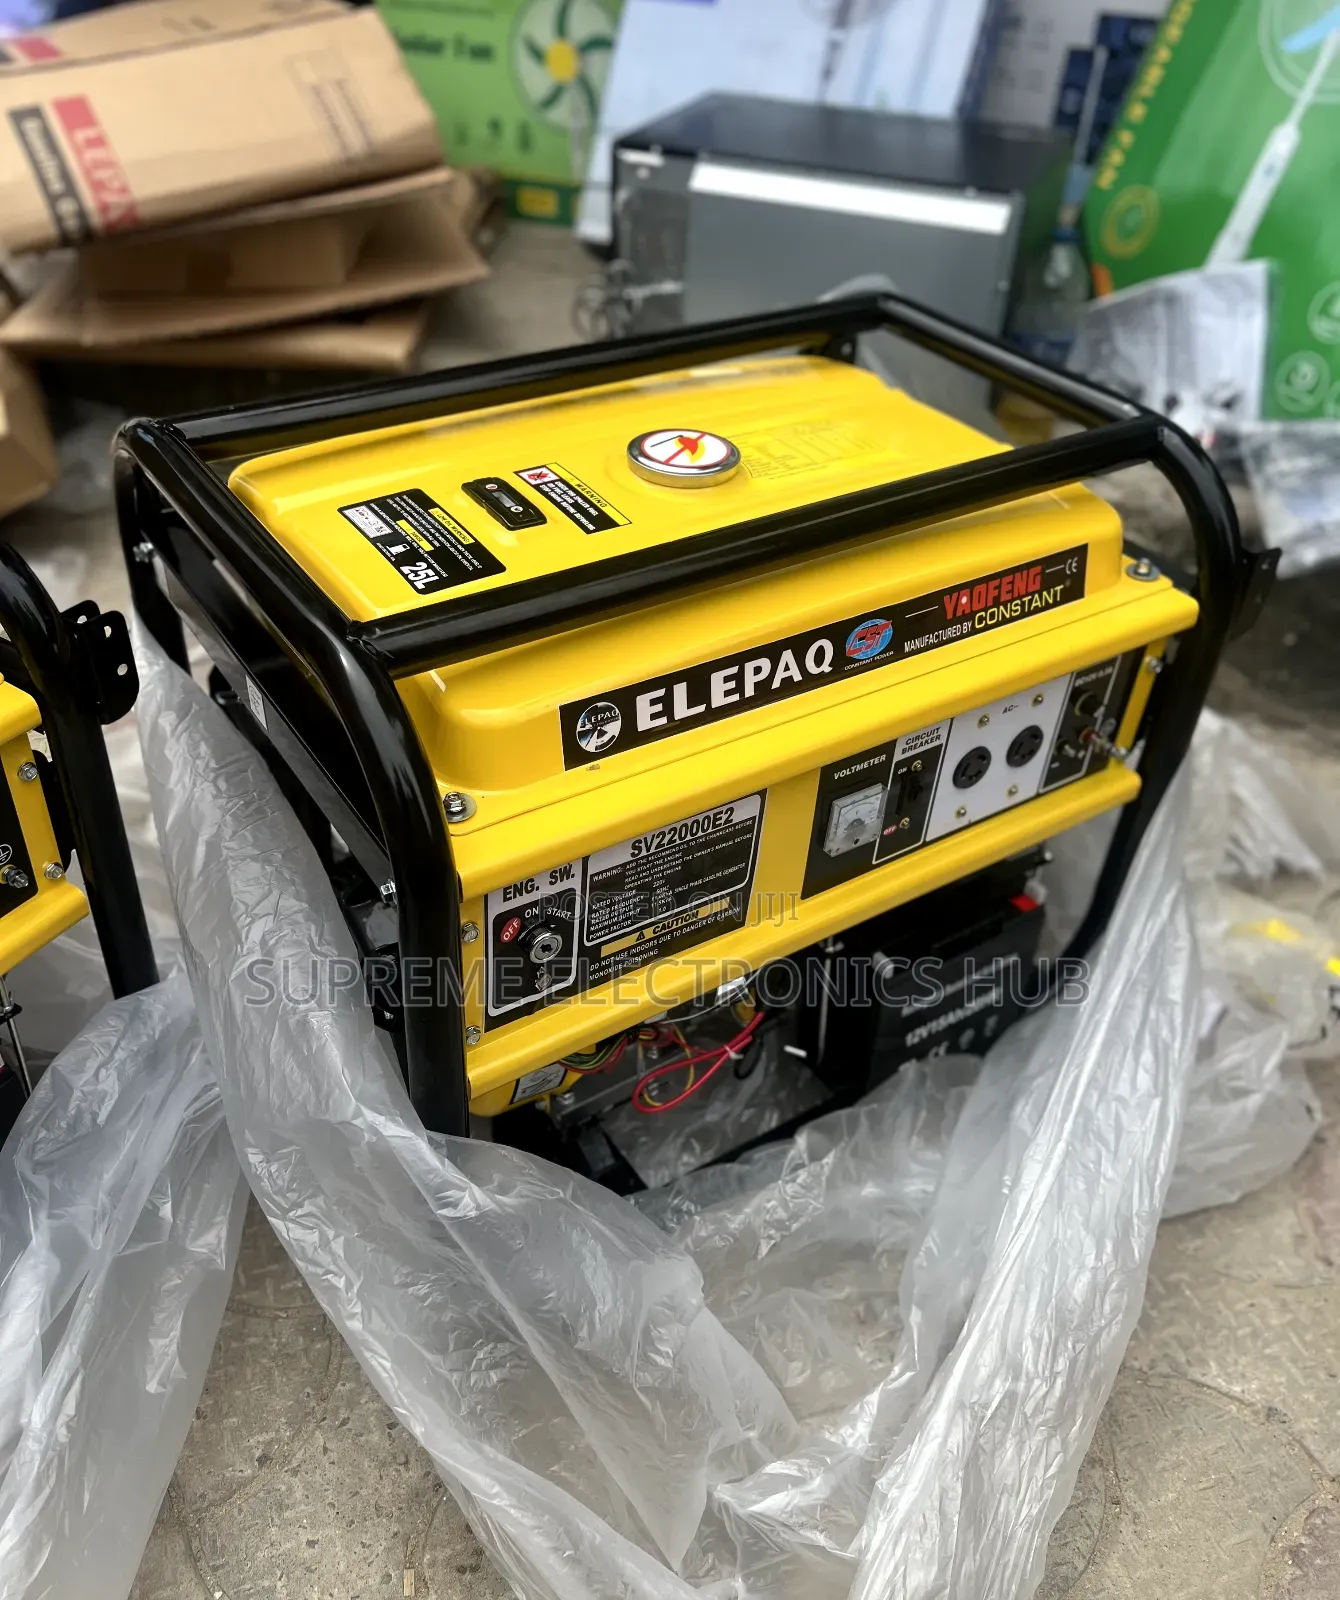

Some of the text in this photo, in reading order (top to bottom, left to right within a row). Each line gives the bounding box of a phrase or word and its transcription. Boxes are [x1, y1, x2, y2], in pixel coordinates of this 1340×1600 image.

[574, 483, 608, 508] WARNING
[399, 561, 440, 590] 25L
[943, 564, 1044, 620] YAOFENG
[903, 584, 1065, 653] MANUFACTURED BY CONSTANT
[844, 650, 894, 671] CONSTANT POWER
[635, 638, 834, 732] ELEPAQ
[901, 734, 942, 755] BREAKER
[905, 726, 941, 746] CIRCUIT
[833, 754, 887, 780] VOLTMETER
[897, 766, 908, 775] ON
[630, 806, 735, 859] SV22000E2
[883, 825, 897, 836] OFF
[648, 846, 679, 861] RECOMMEND
[502, 863, 576, 902] ENG. SW.
[524, 906, 572, 920] ON START
[591, 908, 611, 918] RATED
[592, 900, 611, 910] RATED
[502, 918, 520, 942] OFF
[591, 914, 610, 925] RATED
[652, 909, 700, 935] CAUTION
[590, 963, 600, 972] DO
[600, 956, 615, 967] NOT
[615, 950, 629, 961] USE
[629, 940, 658, 955] INDOORS
[658, 934, 672, 944] DUE
[682, 918, 707, 934] DANGER
[707, 916, 716, 924] OF
[716, 907, 741, 921] CARBON
[589, 948, 659, 981] MONOXIDE POISONING
